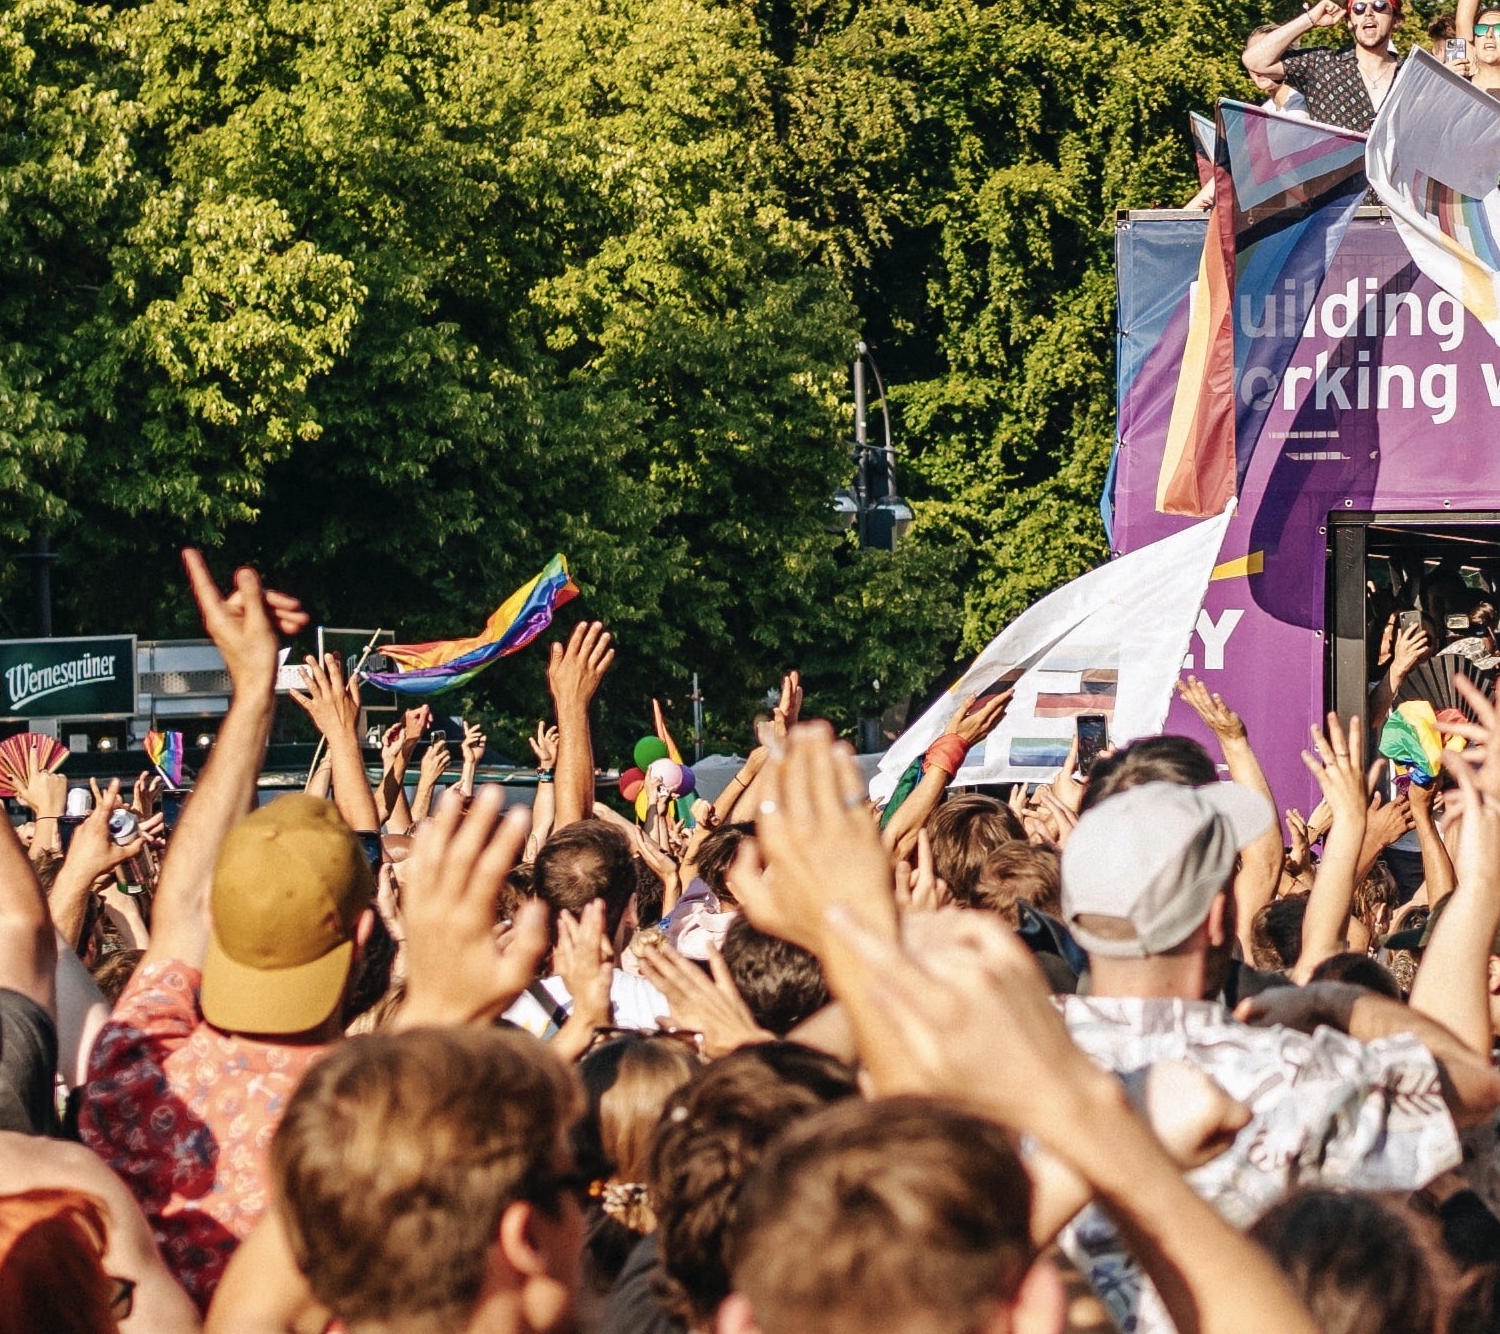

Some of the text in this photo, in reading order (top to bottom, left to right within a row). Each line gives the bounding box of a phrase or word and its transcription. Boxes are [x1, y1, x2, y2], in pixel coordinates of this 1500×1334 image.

[1189, 276, 1465, 353] uilding
[1234, 350, 1459, 425] orking
[1182, 608, 1246, 670] Y
[5, 653, 116, 703] Wernesgrüner
